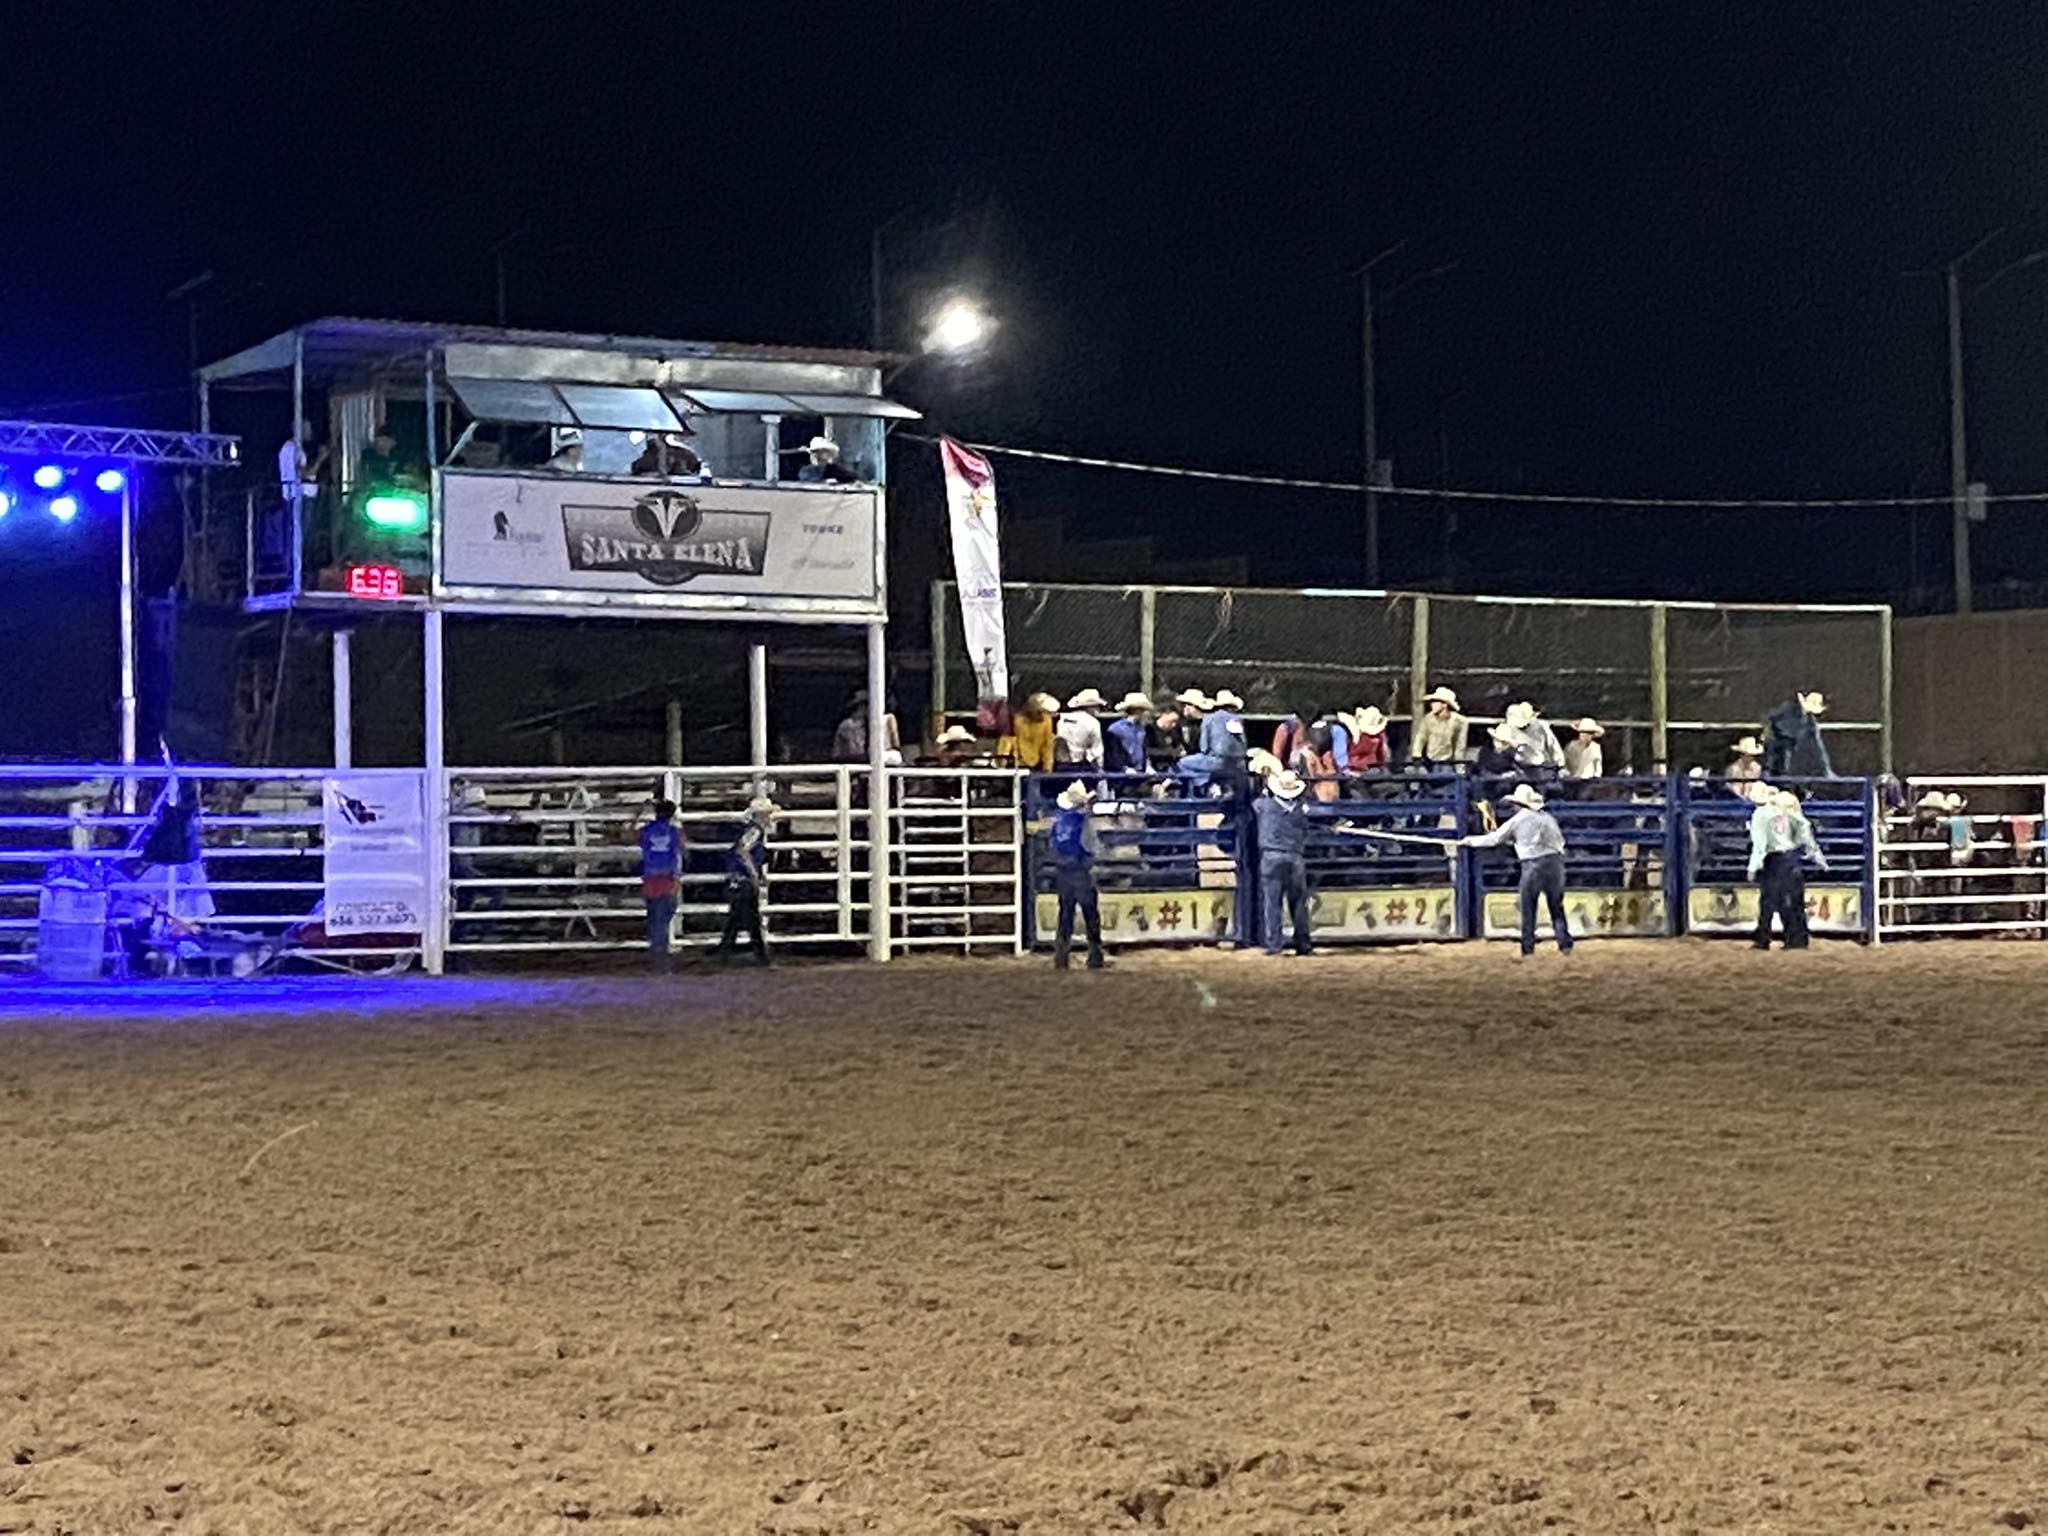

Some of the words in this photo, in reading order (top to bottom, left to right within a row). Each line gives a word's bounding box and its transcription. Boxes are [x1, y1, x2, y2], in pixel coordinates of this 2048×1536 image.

[581, 532, 664, 566] SANTA
[674, 536, 754, 571] ELENA
[1384, 897, 1428, 927] #2
